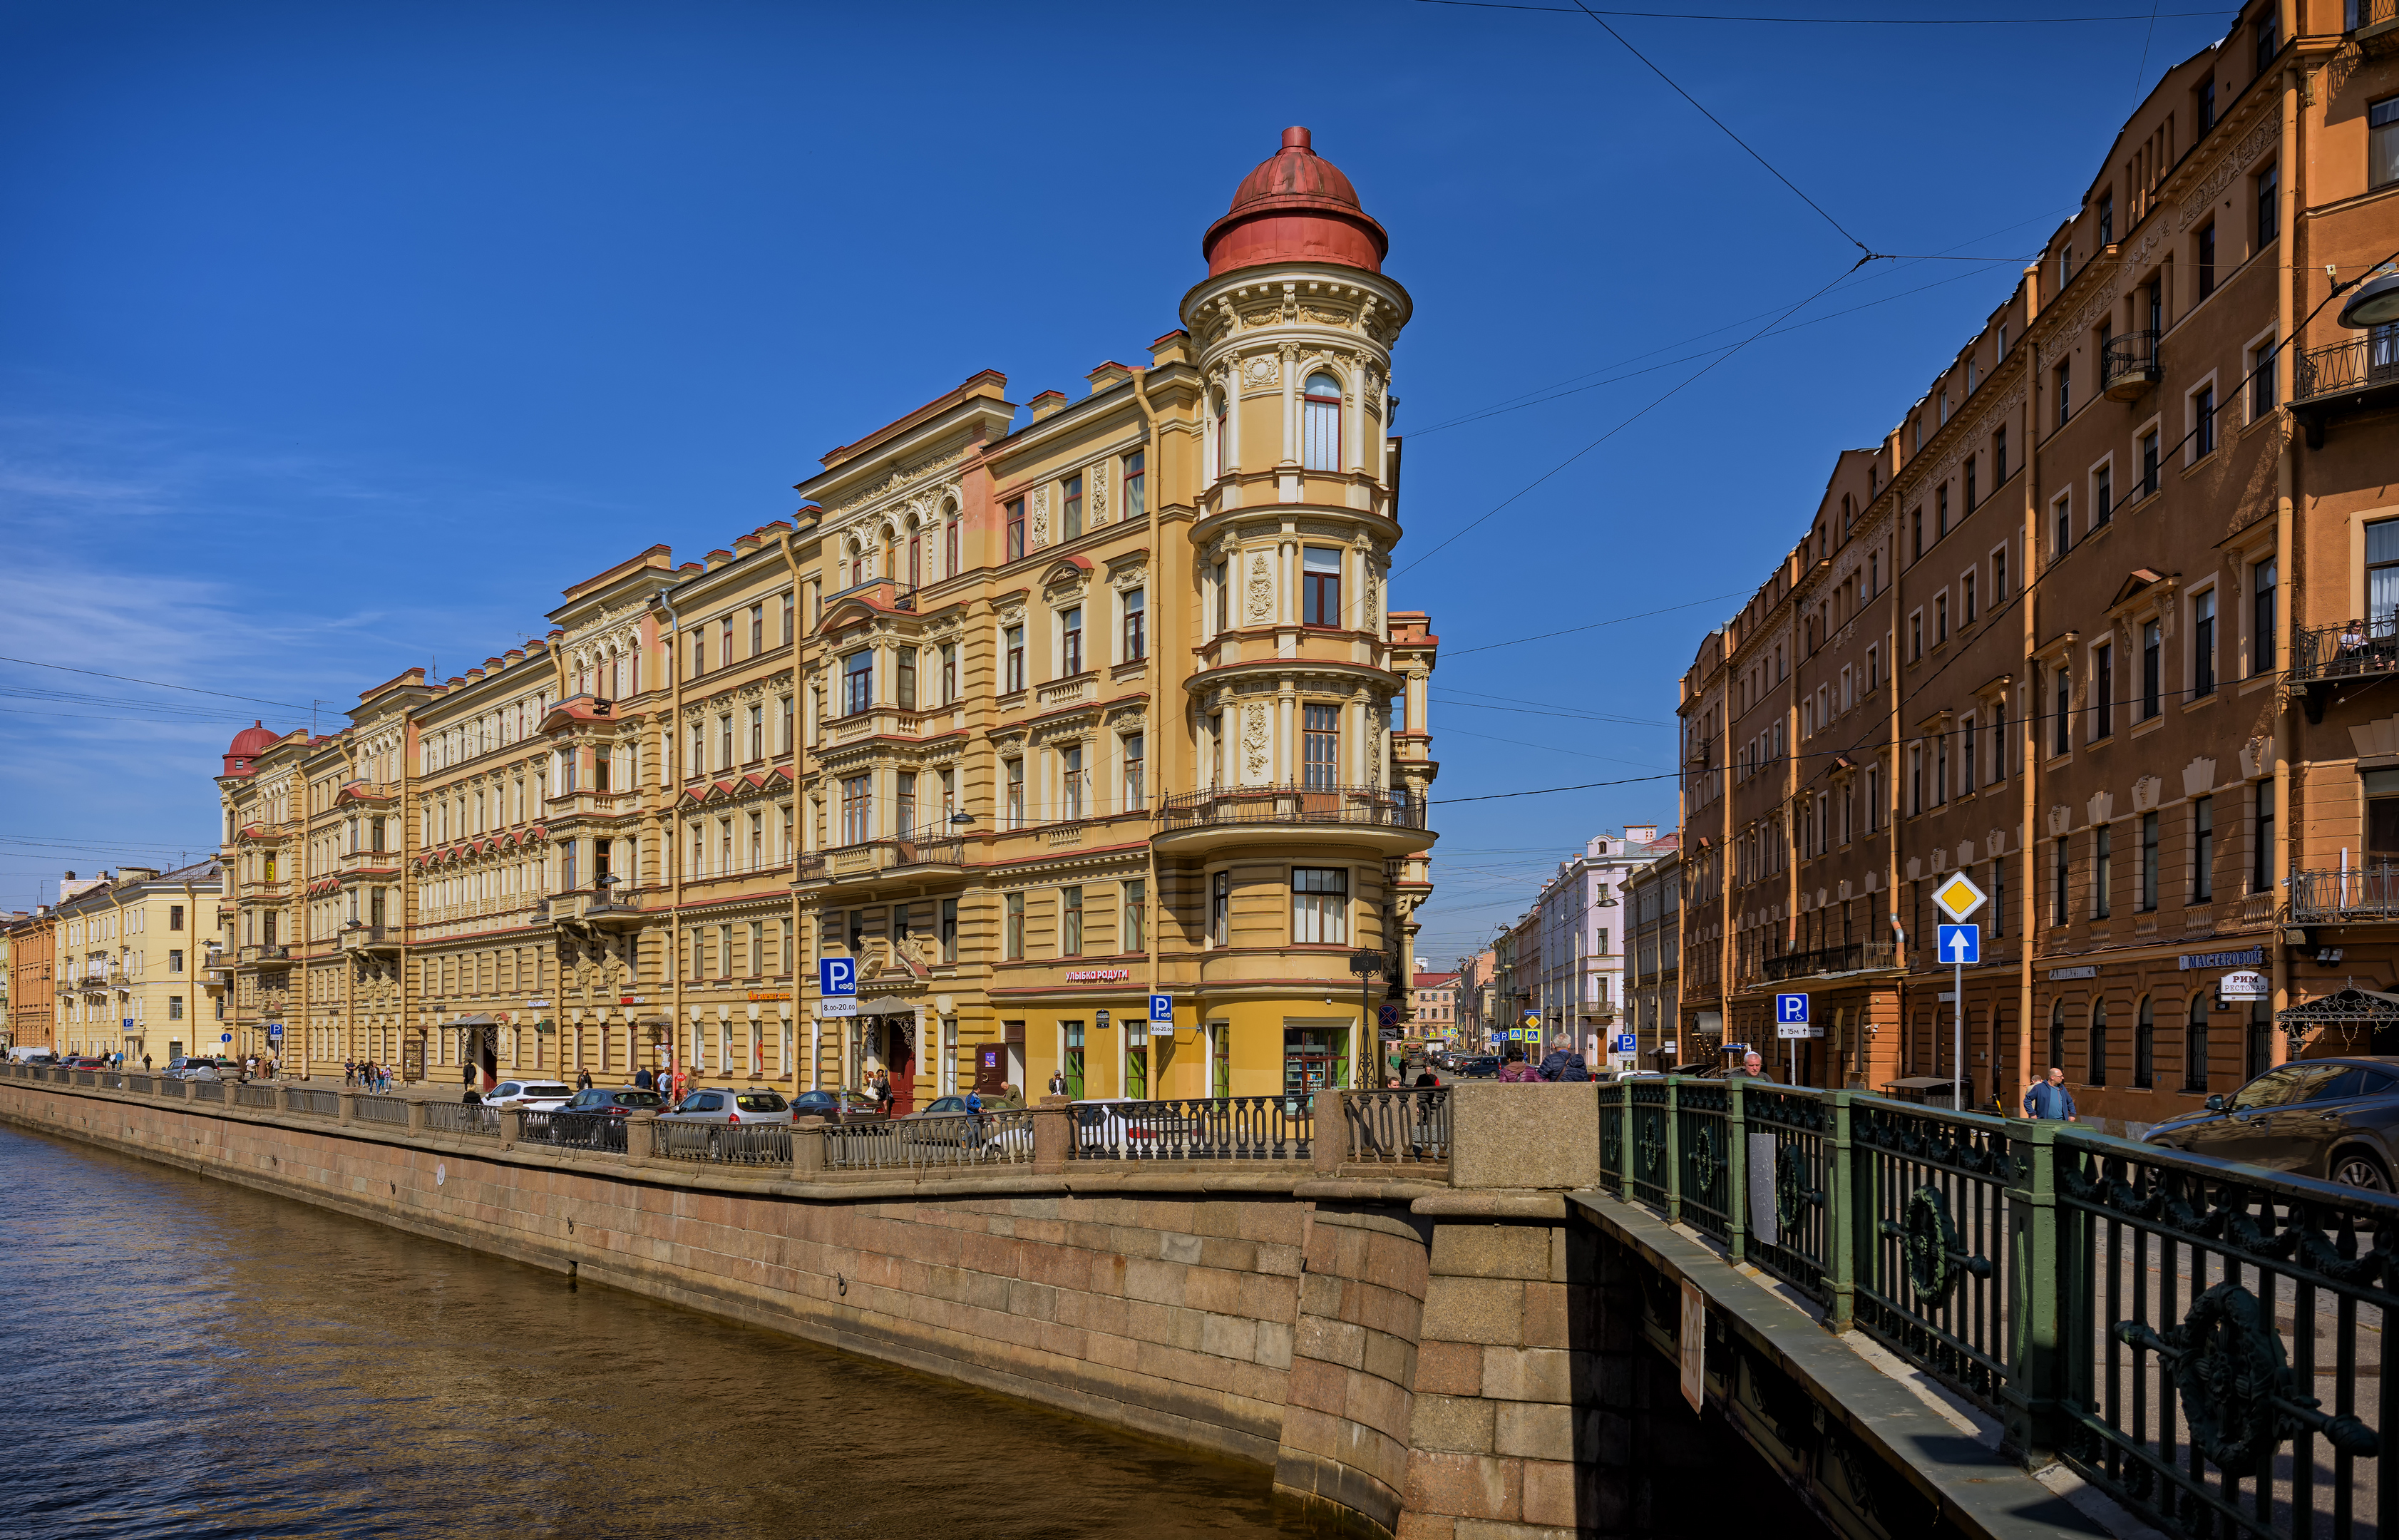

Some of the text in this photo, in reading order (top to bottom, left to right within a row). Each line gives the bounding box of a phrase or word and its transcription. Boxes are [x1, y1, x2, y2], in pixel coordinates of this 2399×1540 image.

[2189, 945, 2261, 968] МАСТЕРОВОЙ
[829, 962, 849, 991] P
[1065, 969, 1129, 980] УЛЫБКА РАДУГИ
[823, 1003, 856, 1012] 8.00-20.00
[1156, 997, 1168, 1018] P
[1785, 997, 1803, 1020] P
[273, 1025, 281, 1034] P
[1622, 1035, 1633, 1050] P
[1683, 1310, 1698, 1379] 2.6
